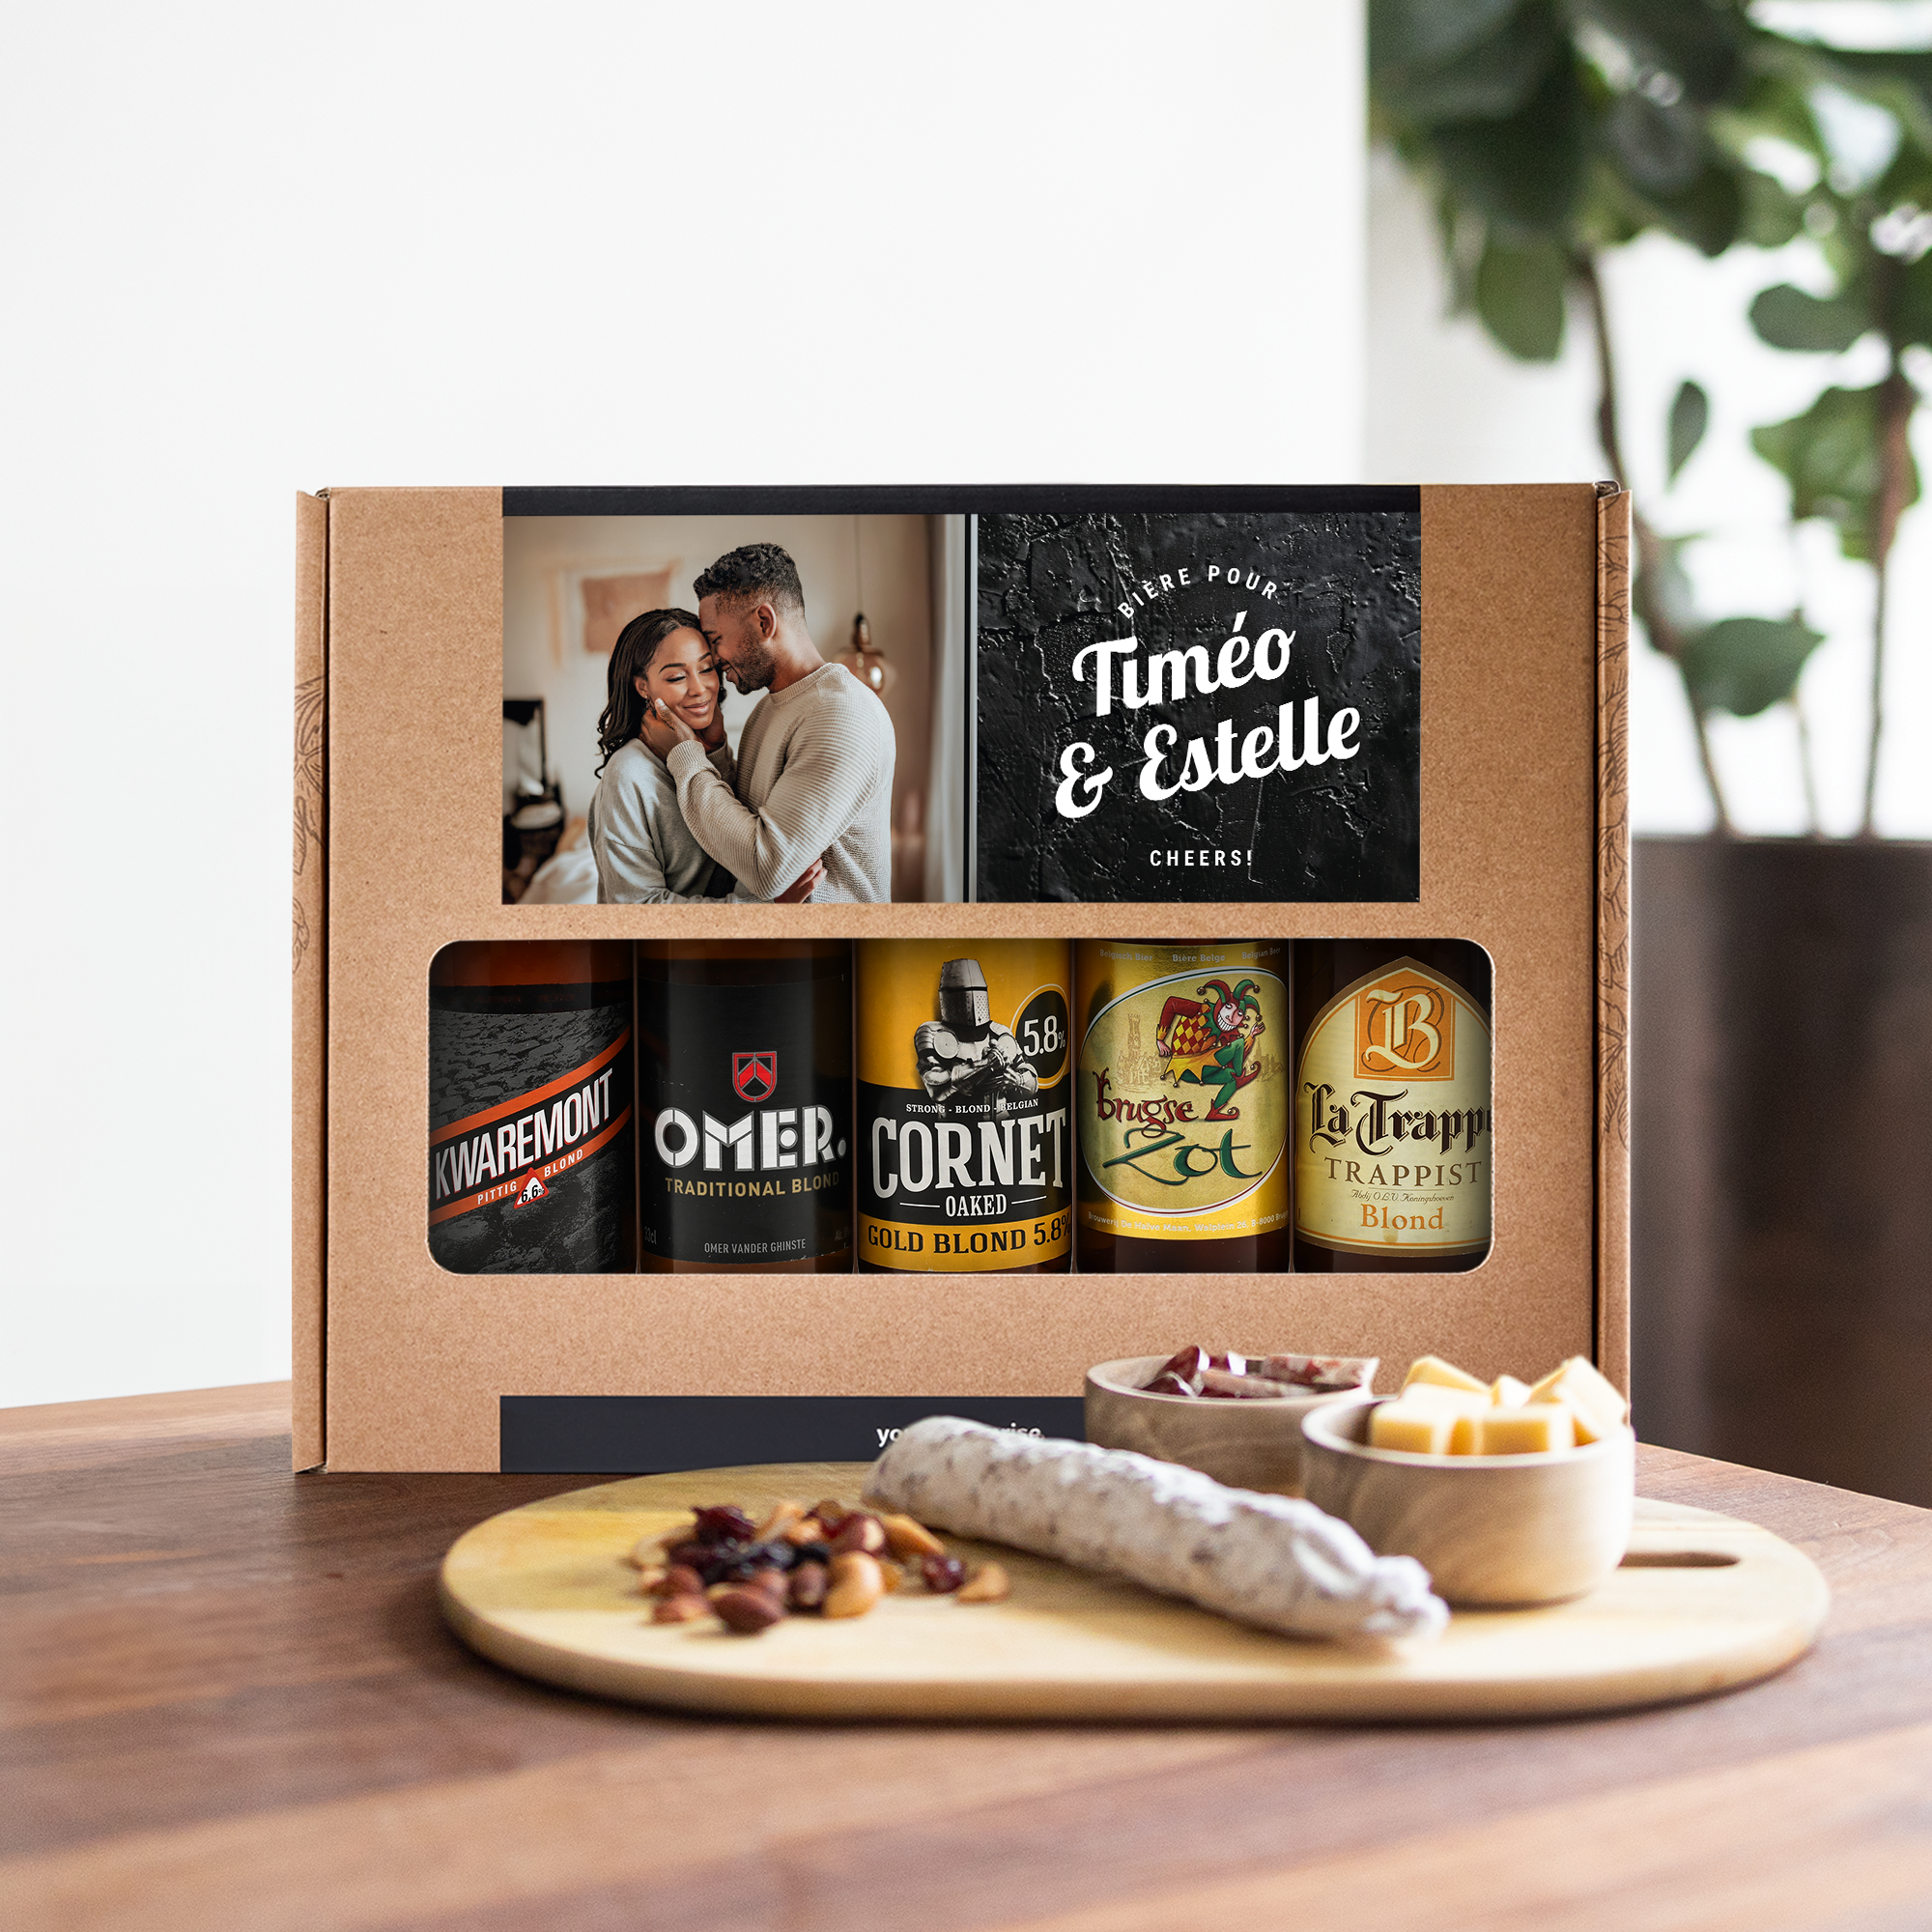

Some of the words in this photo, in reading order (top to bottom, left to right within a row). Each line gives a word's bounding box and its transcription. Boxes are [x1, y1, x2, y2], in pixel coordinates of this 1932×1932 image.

[1118, 567, 1191, 619] BIÈRE
[1208, 564, 1278, 599] POUR
[1055, 741, 1113, 818] &
[1140, 696, 1360, 801] Estelle
[1150, 850, 1253, 867] CHEERS!
[1099, 949, 1132, 961] Belgisch
[1135, 952, 1153, 962] Bier
[1172, 953, 1197, 962] Bière
[1200, 953, 1226, 963] Belge
[1242, 950, 1268, 960] Belgian
[1023, 1015, 1066, 1055] 5.8%
[906, 1103, 946, 1114] STRONG
[955, 1105, 990, 1114] BLOND
[1000, 1098, 1038, 1112] BELGIAN
[1304, 1082, 1353, 1153] La
[1350, 1089, 1492, 1156] Trapp
[436, 1067, 613, 1201] KWAREMONT
[871, 1107, 1066, 1199] CORNET
[1102, 1127, 1263, 1185] Zot
[477, 1181, 517, 1206] PITTIG
[544, 1149, 583, 1178] BLOND
[665, 1177, 785, 1197] TRADITIONAL
[792, 1171, 839, 1195] BLOND
[1324, 1157, 1482, 1187] TRAPPIST
[946, 1194, 1007, 1217] OAKED
[1360, 1204, 1444, 1230] Blond
[868, 1224, 924, 1253] GOLD
[933, 1229, 1027, 1254] BLOND
[1034, 1212, 1071, 1246] 5.8%
[1088, 1211, 1119, 1228] Brouwerij
[1121, 1219, 1132, 1229] De
[1134, 1221, 1160, 1231] Halve
[1163, 1222, 1191, 1233] Maan,
[1194, 1222, 1235, 1233] Walplein
[1251, 1214, 1275, 1227] B-8000
[704, 1242, 729, 1254] OMER
[731, 1241, 768, 1254] VANDER
[770, 1238, 807, 1253] GHINSTE
